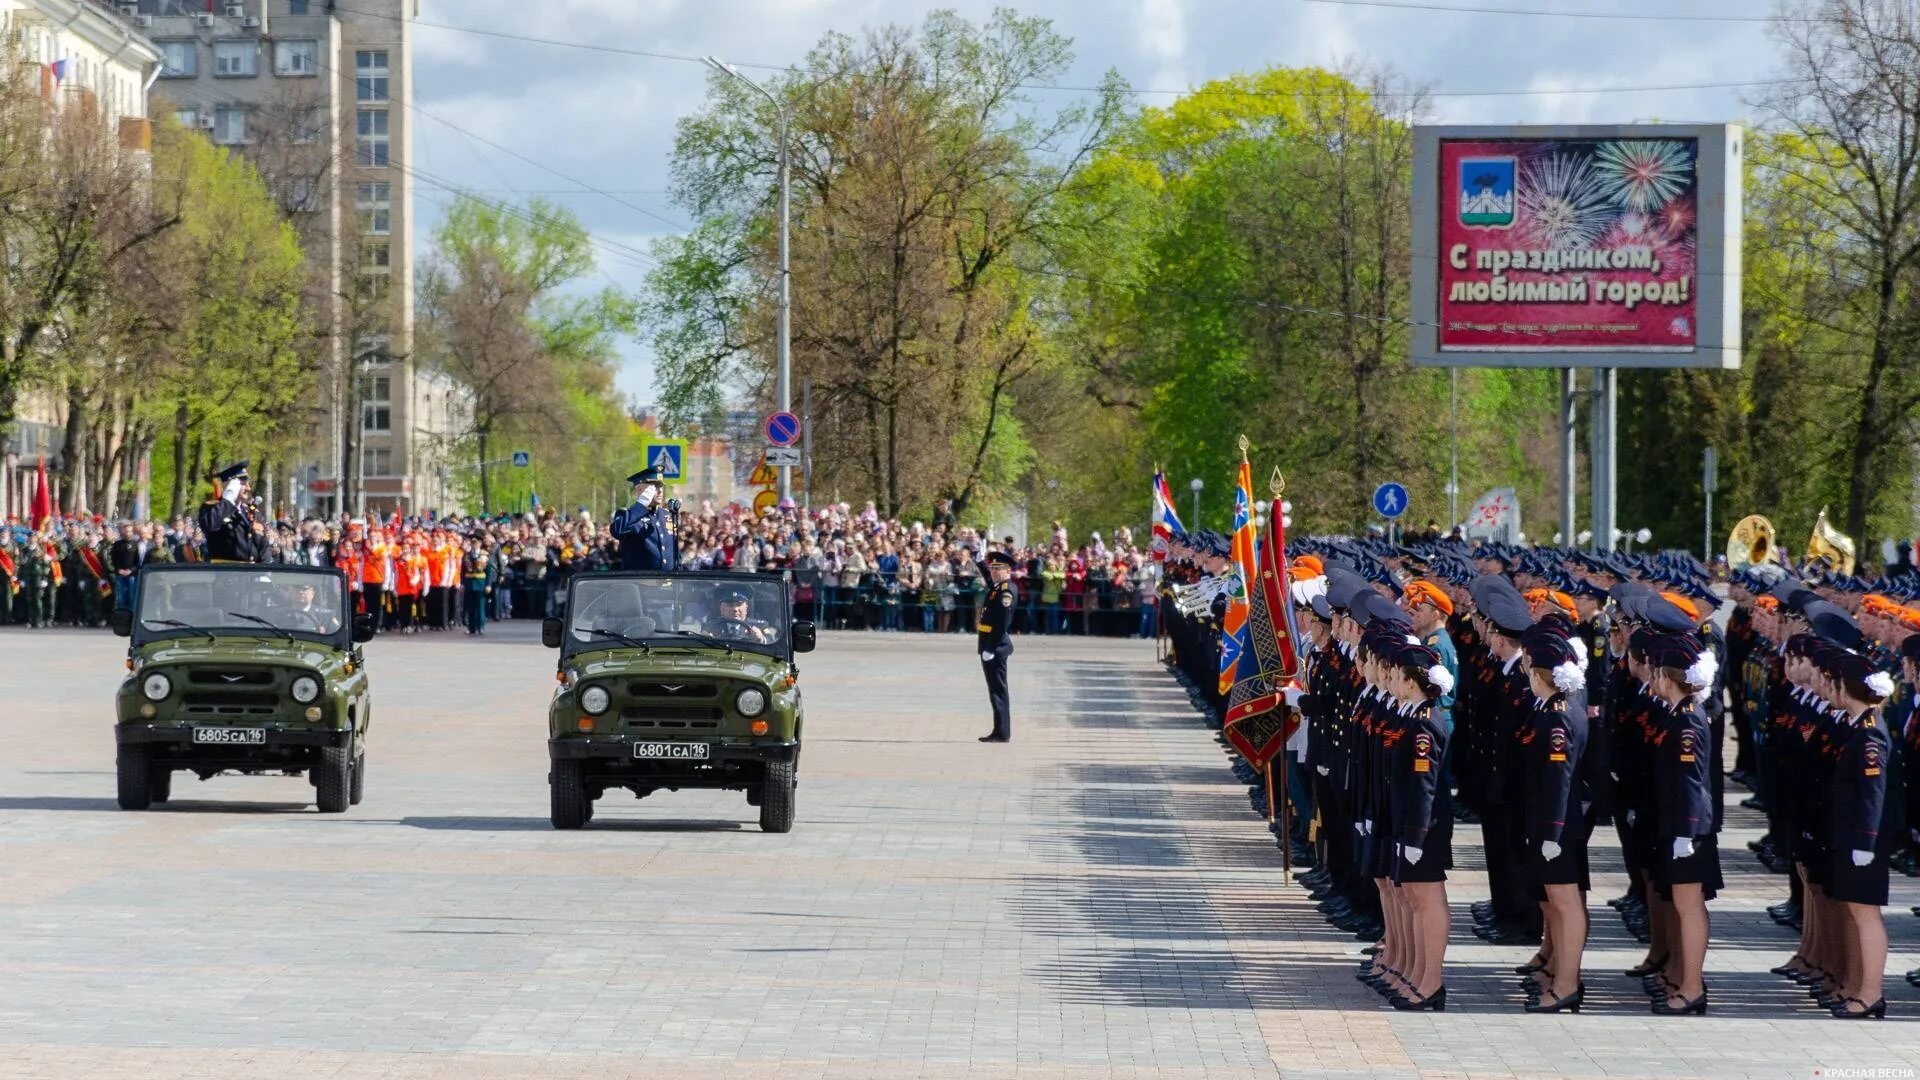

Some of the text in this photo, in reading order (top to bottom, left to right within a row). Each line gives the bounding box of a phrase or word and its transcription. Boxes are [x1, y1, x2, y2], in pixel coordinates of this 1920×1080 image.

[1450, 244, 1661, 276] С праздником,
[1449, 275, 1690, 308] любимый город!
